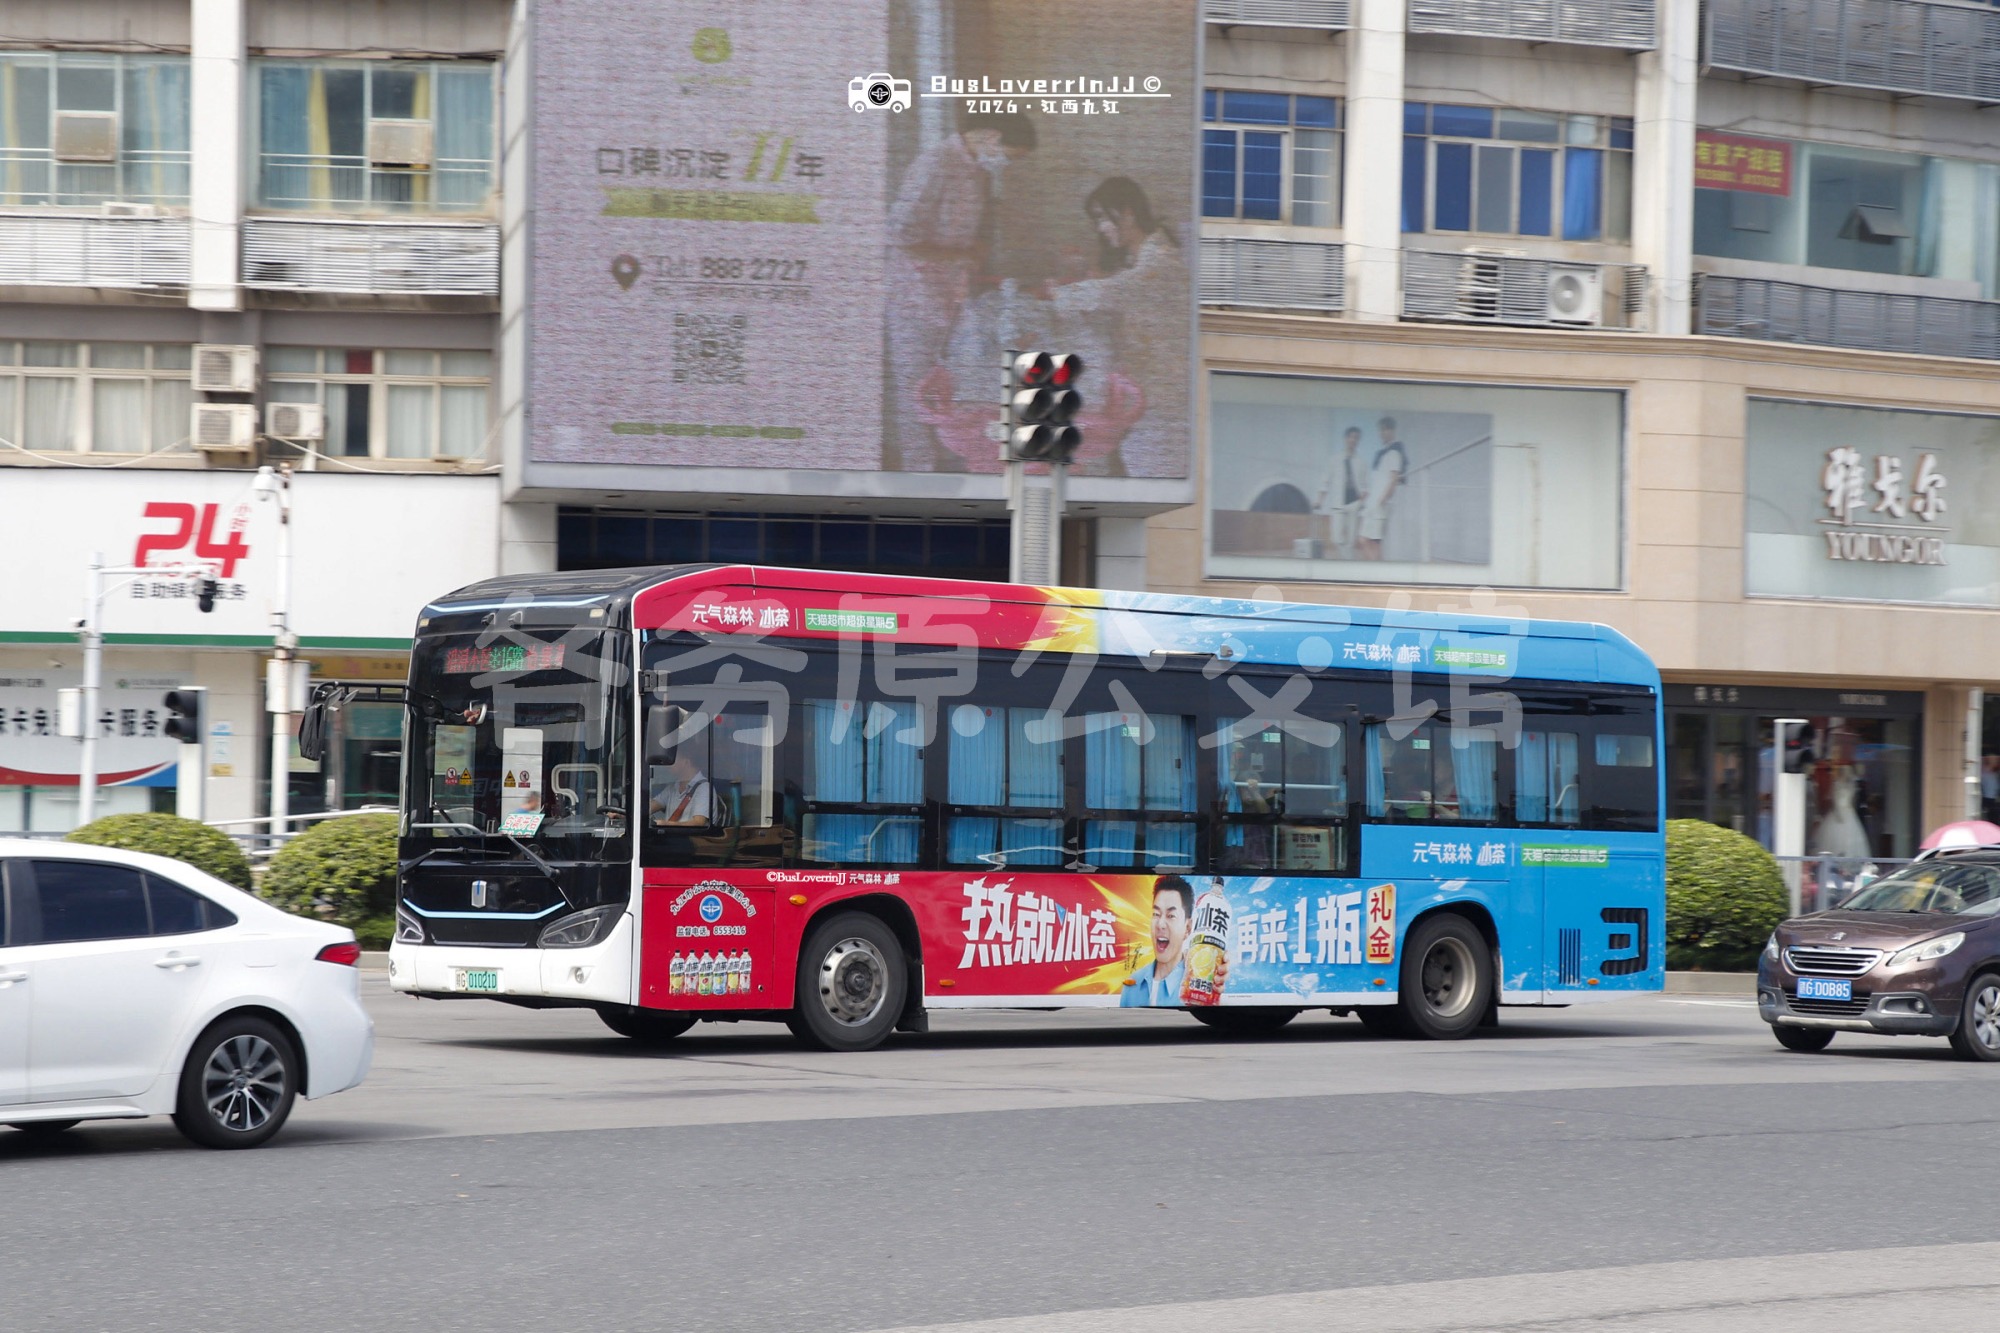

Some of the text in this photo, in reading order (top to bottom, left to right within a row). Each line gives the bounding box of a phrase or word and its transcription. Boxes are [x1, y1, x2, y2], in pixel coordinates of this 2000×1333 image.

[1822, 446, 1948, 526] 雅戈尔
[134, 501, 250, 578] 24
[1825, 531, 1947, 566] YOUNGOR
[692, 603, 754, 627] 元气森林
[759, 605, 790, 629] 冰茶
[1343, 642, 1393, 662] 元气森林
[1413, 842, 1472, 865] 元气森林
[1476, 841, 1506, 867] 冰茶
[957, 875, 1117, 970] 热就冰茶
[1237, 890, 1363, 965] 再来1瓶
[1369, 890, 1393, 959] 礼金
